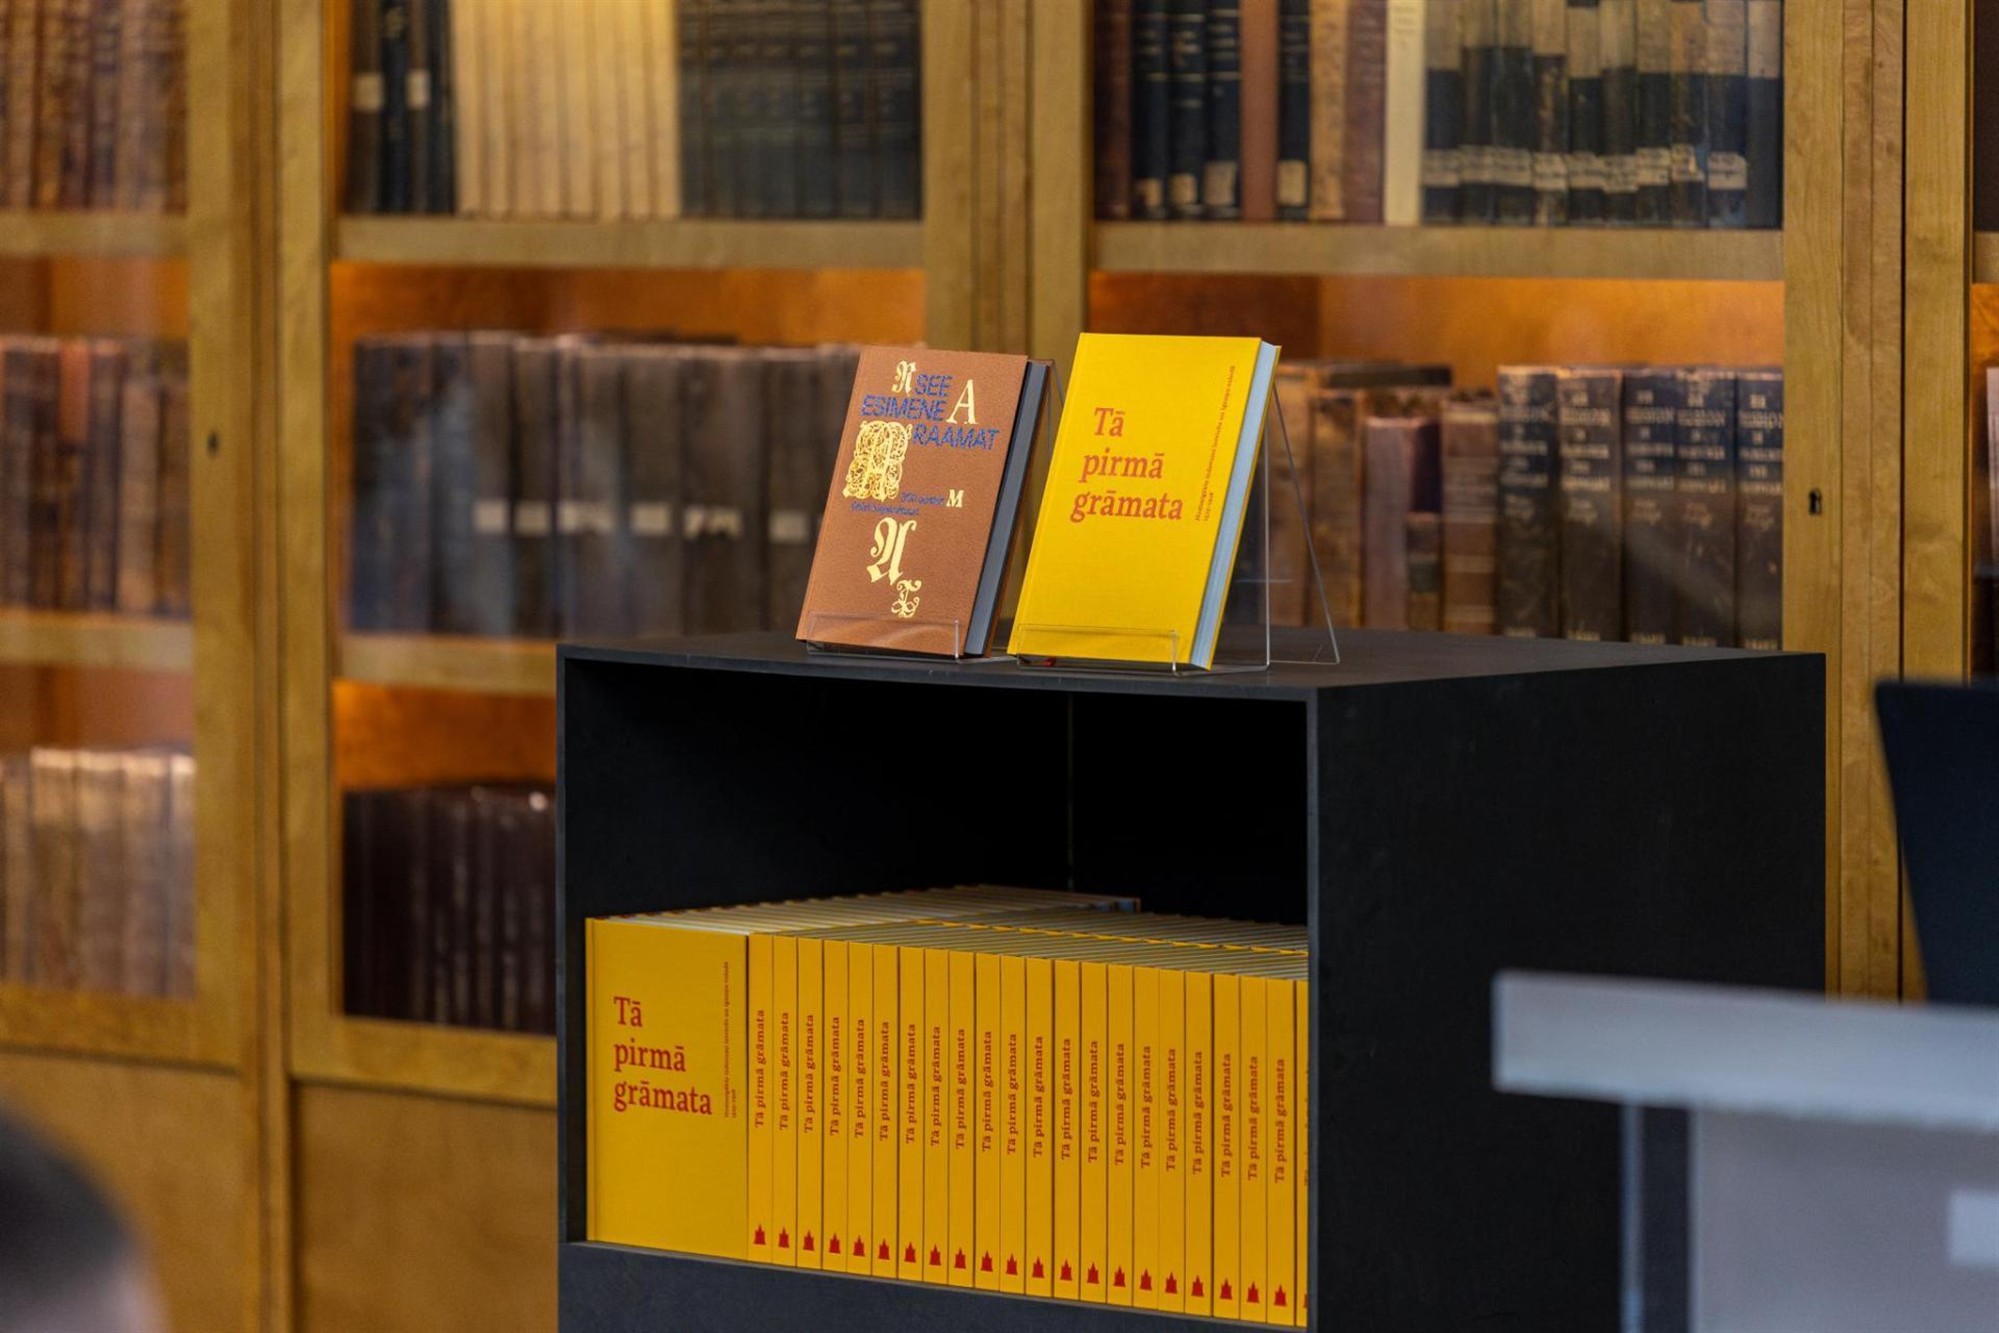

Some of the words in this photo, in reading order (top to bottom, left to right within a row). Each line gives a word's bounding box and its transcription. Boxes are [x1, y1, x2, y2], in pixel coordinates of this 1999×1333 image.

[915, 374, 953, 397] SEE
[946, 379, 978, 424] A
[861, 395, 947, 421] ESIMENE
[1094, 407, 1125, 437] Tā
[913, 424, 999, 449] RAAMAT
[1078, 447, 1165, 483] pirmā
[946, 489, 964, 508] M
[1070, 490, 1183, 523] grāmata
[613, 996, 642, 1027] Tā
[613, 1037, 686, 1072] pirmā
[756, 1010, 767, 1065] grāmata
[780, 1012, 791, 1067] grāmata
[805, 1015, 816, 1070] grāmata
[831, 1017, 842, 1072] grāmata
[856, 1019, 867, 1075] grāmata
[880, 1022, 891, 1077] grāmata
[907, 1024, 918, 1080] grāmata
[932, 1026, 943, 1082] grāmata
[956, 1029, 967, 1085] grāmata
[983, 1031, 994, 1087] grāmata
[1008, 1034, 1019, 1090] grāmata
[1034, 1036, 1045, 1092] grāmata
[1062, 1039, 1073, 1095] grāmata
[1089, 1042, 1100, 1098] grāmata
[1116, 1044, 1127, 1101] grāmata
[1142, 1047, 1153, 1103] grāmata
[1167, 1049, 1178, 1106] grāmata
[613, 1080, 712, 1115] grāmata
[755, 1069, 766, 1108] pirmā
[779, 1071, 790, 1111] pirmā
[804, 1073, 816, 1113] pirmā
[830, 1076, 842, 1116] pirmā
[855, 1078, 866, 1119] pirmā
[1193, 1052, 1204, 1108] grāmata
[1222, 1055, 1233, 1111] grāmata
[1249, 1058, 1260, 1114] grāmata
[1275, 1060, 1286, 1117] grāmata
[754, 1112, 765, 1128] Tā
[879, 1081, 890, 1121] pirmā
[906, 1083, 918, 1124] pirmā
[931, 1086, 942, 1126] pirmā
[955, 1088, 966, 1129] pirmā
[982, 1091, 994, 1132] pirmā
[1007, 1093, 1018, 1134] pirmā
[1033, 1096, 1044, 1137] pirmā
[1061, 1099, 1072, 1140] pirmā
[778, 1115, 789, 1130] Tā
[803, 1117, 814, 1133] Tā
[829, 1120, 840, 1136] Tā
[854, 1122, 865, 1138] Tā
[878, 1125, 889, 1141] Tā
[905, 1128, 916, 1144] Tā
[930, 1130, 941, 1146] Tā
[954, 1133, 965, 1149] Tā
[1088, 1102, 1100, 1143] pirmā
[1115, 1104, 1126, 1145] pirmā
[1141, 1107, 1152, 1148] pirmā
[1166, 1110, 1178, 1151] pirmā
[1192, 1112, 1204, 1154] pirmā
[1221, 1116, 1232, 1157] pirmā
[1248, 1118, 1260, 1159] pirmā
[1274, 1121, 1286, 1162] pirmā
[981, 1135, 992, 1152] Tā
[1006, 1138, 1017, 1154] Tā
[1032, 1141, 1043, 1157] Tā
[1060, 1144, 1071, 1160] Tā
[1087, 1147, 1098, 1163] Tā
[1114, 1150, 1125, 1166] Tā
[1140, 1152, 1151, 1169] Tā
[1165, 1155, 1176, 1172] Tā
[1191, 1158, 1202, 1174] Tā
[1220, 1161, 1231, 1177] Tā
[1247, 1164, 1258, 1180] Tā
[1273, 1167, 1284, 1183] Tā
